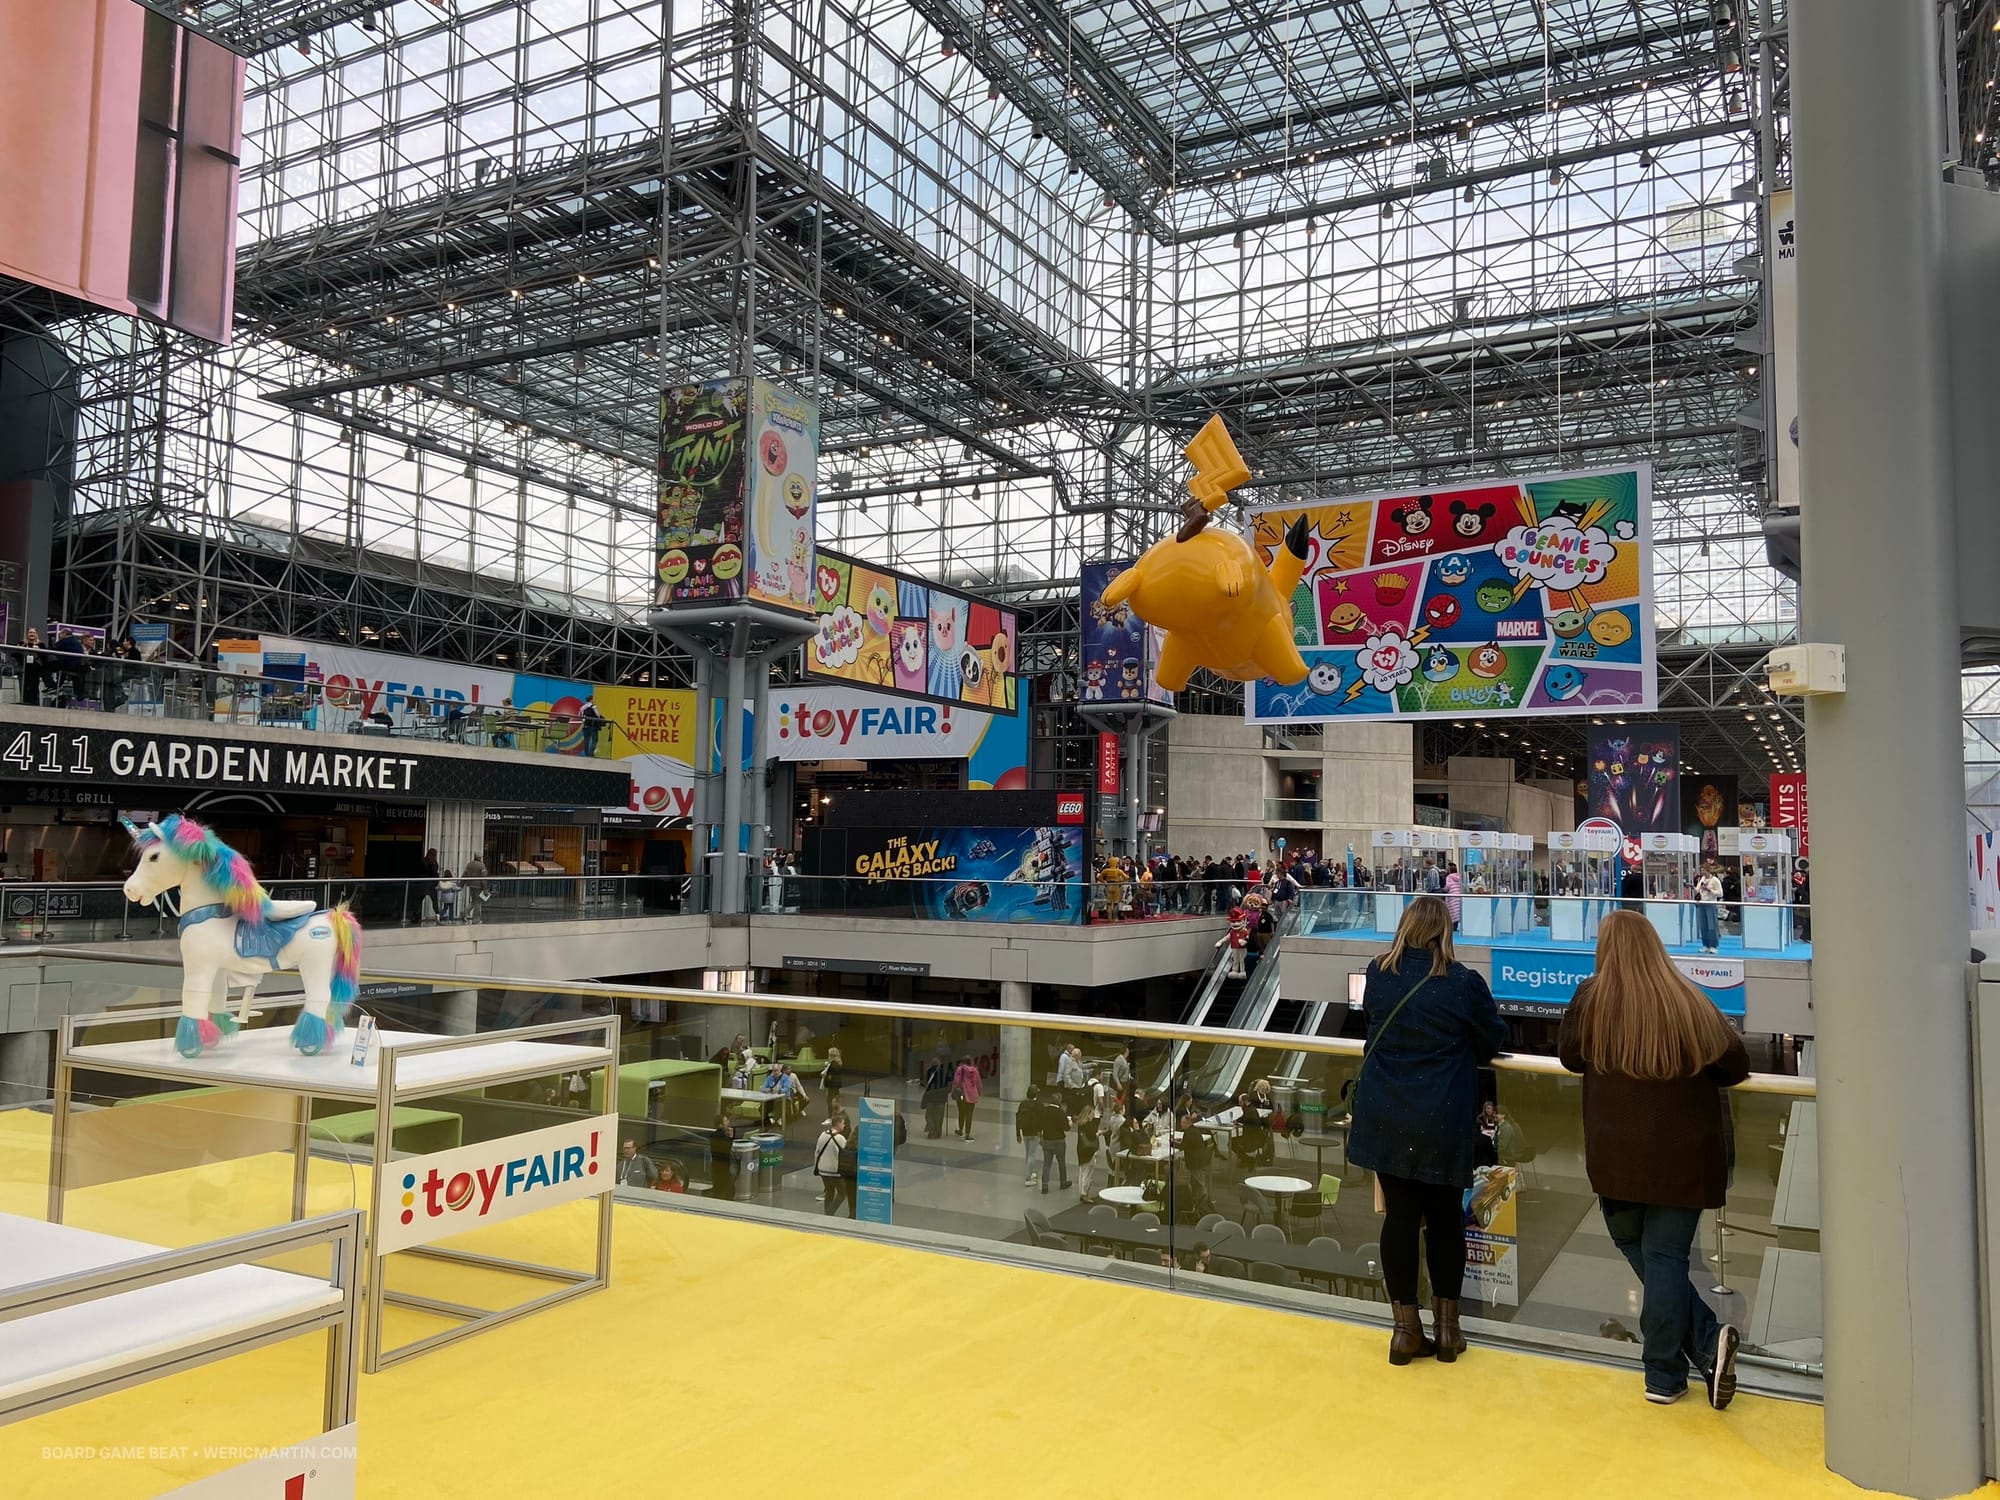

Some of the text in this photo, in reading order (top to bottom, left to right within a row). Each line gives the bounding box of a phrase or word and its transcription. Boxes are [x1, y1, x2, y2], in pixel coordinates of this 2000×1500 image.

[1525, 531, 1590, 555] BEANIE
[1505, 548, 1601, 574] BOUNCERS
[818, 568, 837, 596] ty
[822, 614, 852, 640] BEANIE
[1496, 621, 1539, 637] MARVEL
[819, 627, 859, 659] BOUNCERS
[1559, 641, 1598, 650] STAR
[1373, 648, 1397, 668] ty
[1559, 650, 1598, 658] WARS
[1388, 668, 1408, 681] YEARS
[628, 697, 681, 713] PLAY IS
[627, 712, 681, 728] EVERY
[627, 728, 680, 743] WHERE
[3, 731, 418, 792] 411 GARDEN MARKET
[76, 793, 115, 804] GRILL
[1779, 784, 1795, 828] VITS
[386, 807, 427, 818] BEVERAG
[1057, 802, 1082, 816] LEGO
[888, 836, 907, 849] THE
[856, 840, 939, 874] GALAXY
[913, 856, 956, 876] BACK!
[376, 986, 397, 994] Meeting
[1509, 1004, 1519, 1012] 3B
[1537, 1006, 1562, 1016] Crystal
[1466, 1242, 1489, 1250] EWOOD
[1467, 1249, 1493, 1263] RBY
